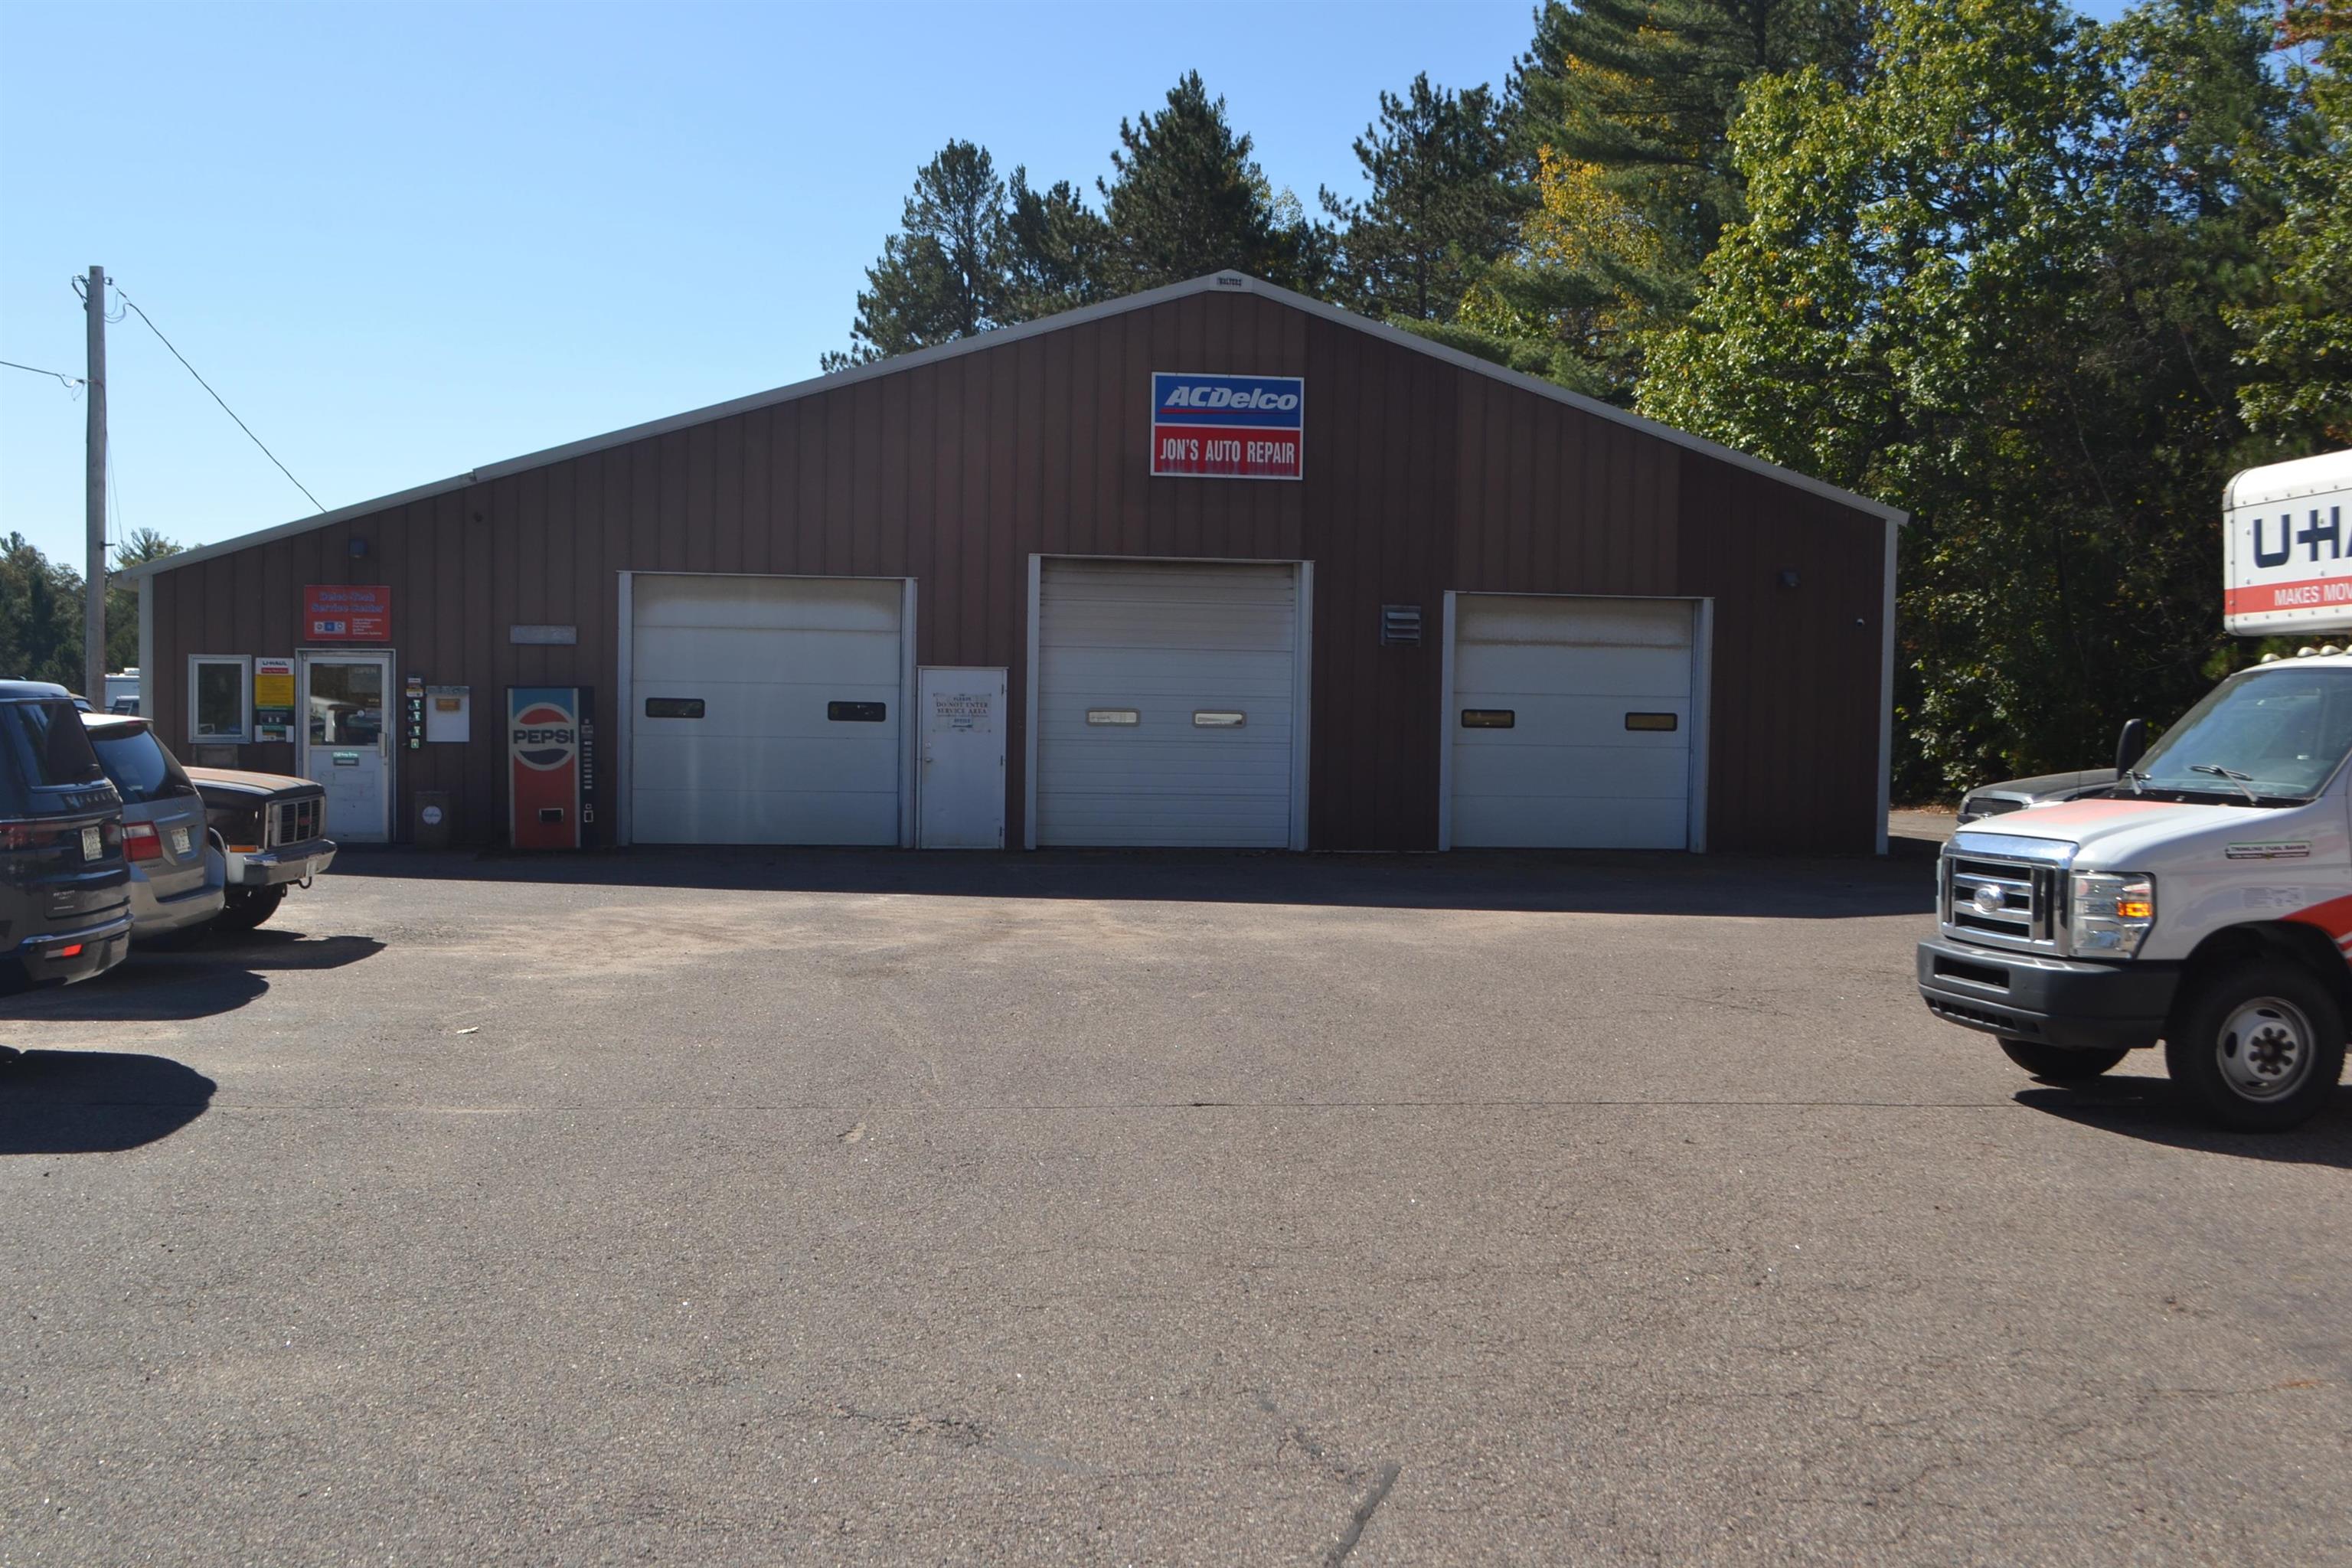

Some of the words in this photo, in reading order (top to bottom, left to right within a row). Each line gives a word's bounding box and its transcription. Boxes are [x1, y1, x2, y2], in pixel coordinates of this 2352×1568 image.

[1165, 386, 1298, 410] ACDelco
[1160, 439, 1199, 460] JON'S
[1205, 439, 1240, 462] AUTO
[1246, 441, 1295, 464] REPAIR
[2253, 506, 2352, 569] U-H
[2275, 586, 2319, 606] MAKES
[513, 729, 575, 744] PEPSI
